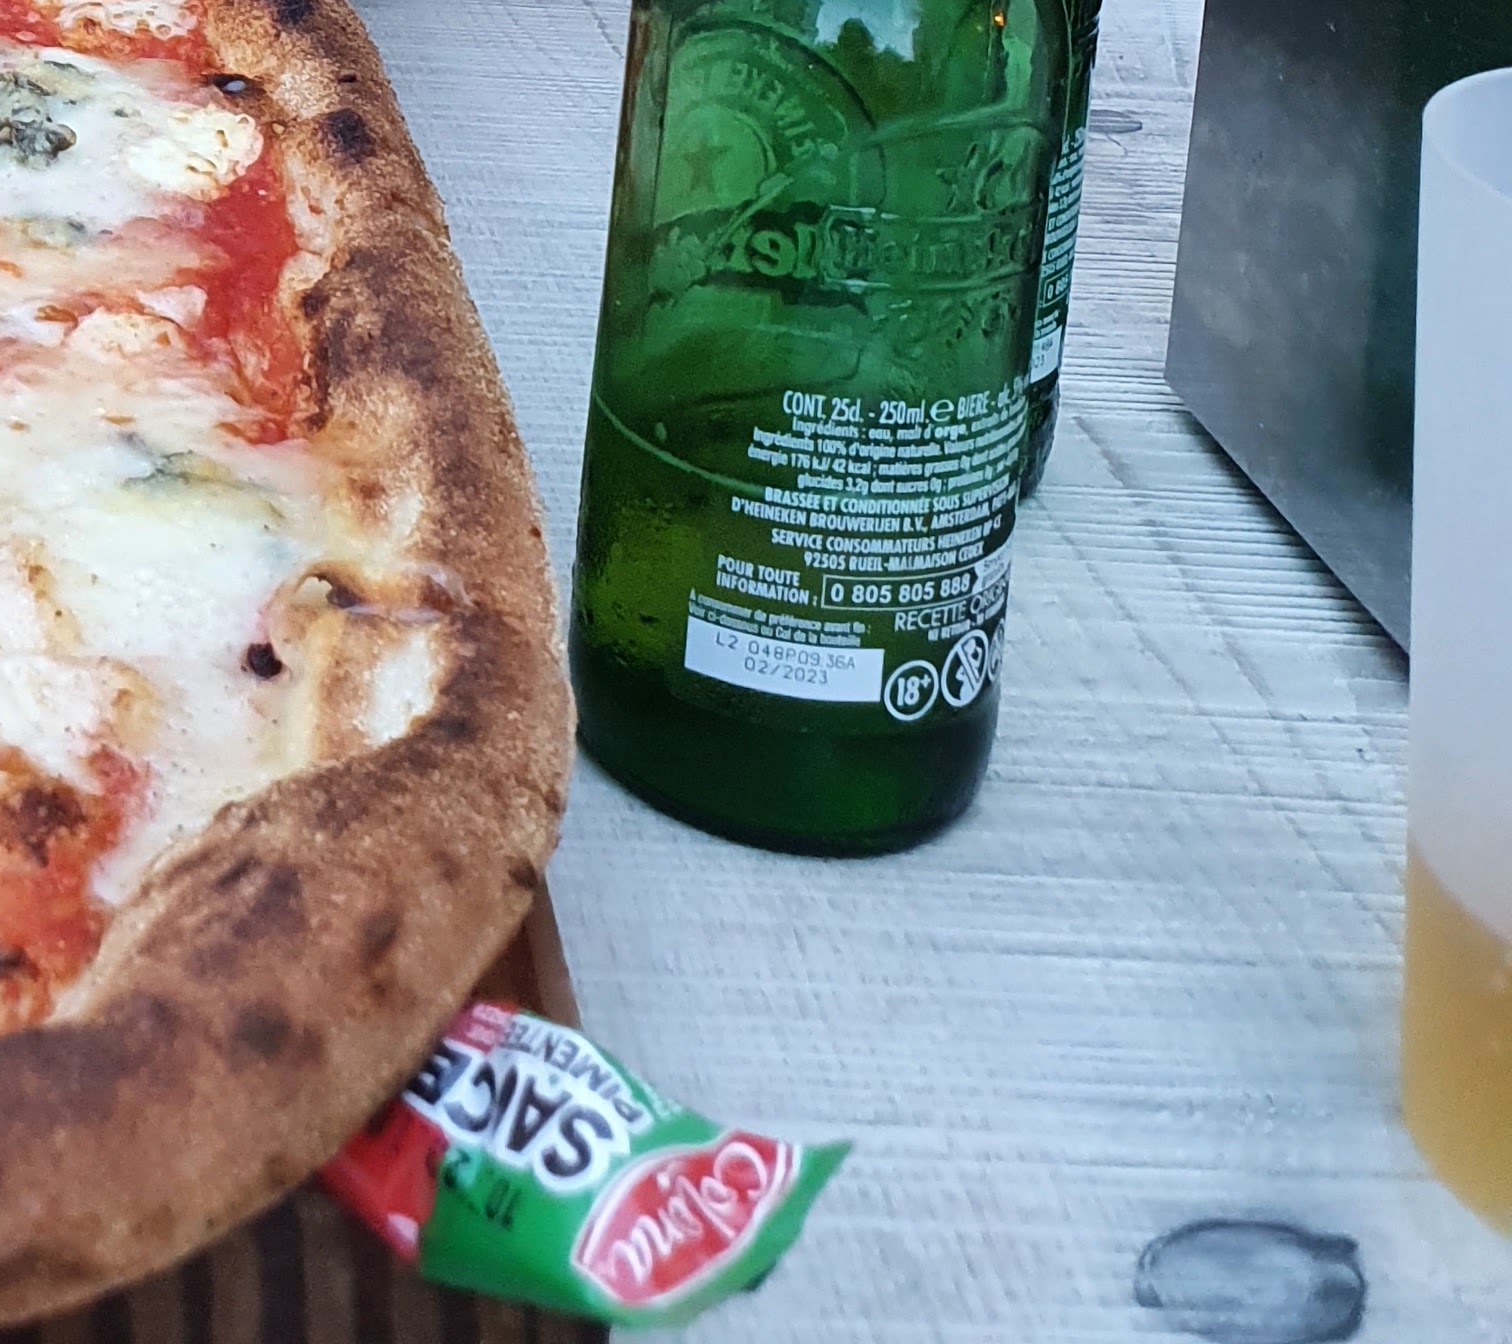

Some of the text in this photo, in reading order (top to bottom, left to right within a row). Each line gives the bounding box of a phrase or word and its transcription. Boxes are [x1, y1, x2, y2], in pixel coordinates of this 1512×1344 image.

[783, 390, 827, 420] CONT.
[731, 496, 807, 525] D'HEINEKEN
[764, 486, 821, 510] BRASSÉE
[823, 496, 839, 511] ET
[840, 496, 931, 515] CONDITIONNÉE
[932, 494, 960, 512] SOUS
[771, 528, 823, 551] SERVICE
[826, 535, 936, 554] CONSOMMATEURS
[717, 554, 801, 587] POUR TOUTE
[804, 551, 846, 571] 92505
[849, 550, 957, 572] RUEIL-MALMAISON
[716, 570, 810, 606] INFORMATION
[830, 582, 844, 603] 0
[851, 584, 893, 604] 805
[898, 580, 935, 603] 805
[940, 572, 971, 598] 888
[894, 600, 967, 632] RECETTE
[715, 631, 739, 651] L2
[744, 657, 828, 685] 02/2023
